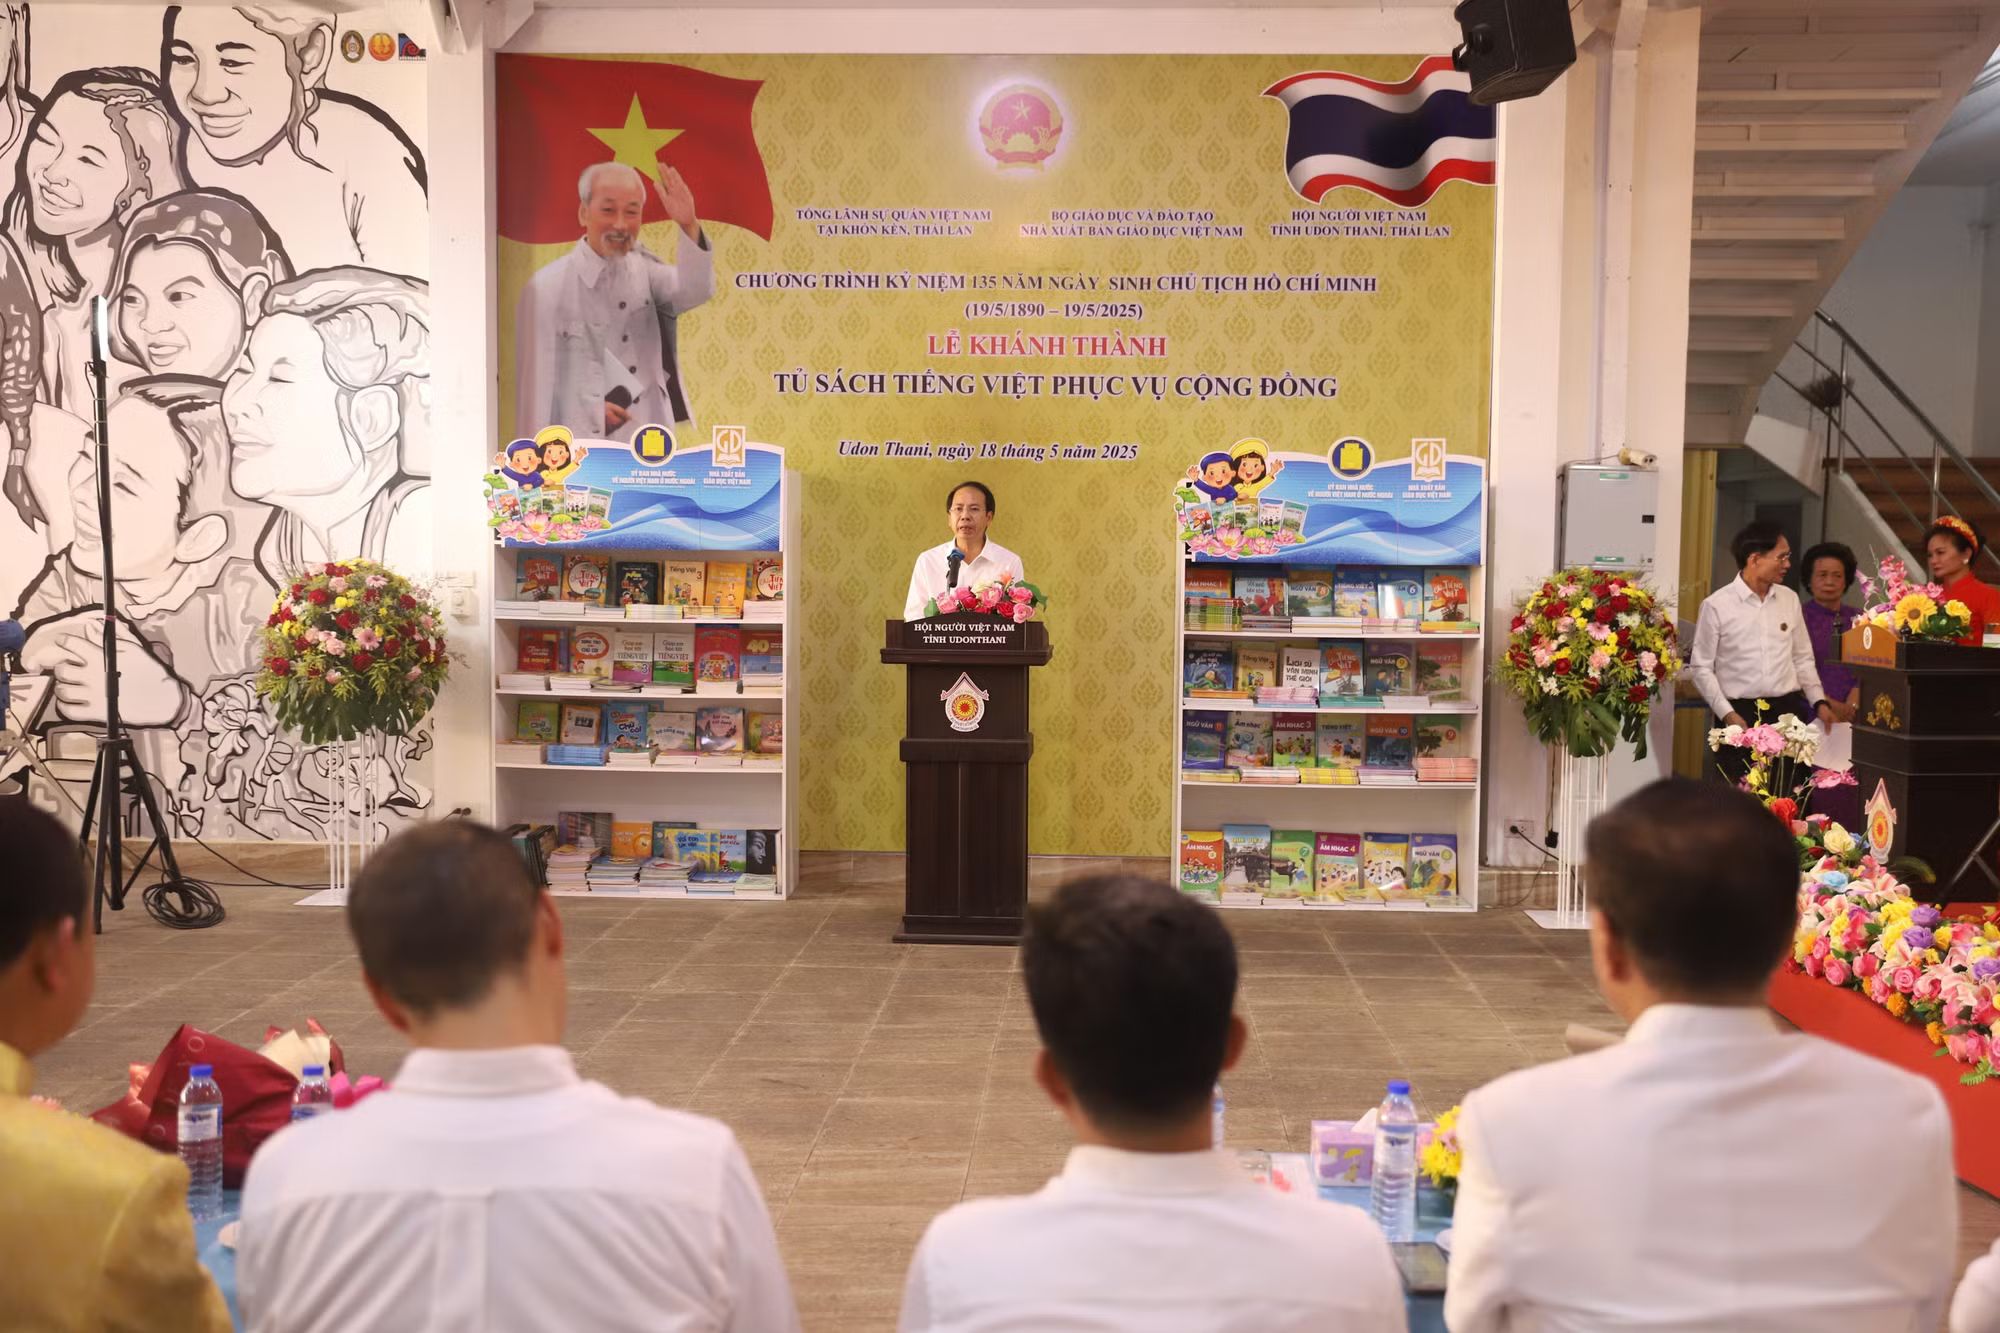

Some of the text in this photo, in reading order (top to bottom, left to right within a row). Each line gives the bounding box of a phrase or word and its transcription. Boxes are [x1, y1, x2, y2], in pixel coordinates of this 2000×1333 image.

[931, 209, 958, 222] VIỆT
[963, 210, 991, 220] NAM
[1072, 208, 1104, 221] GIÁO
[1107, 211, 1133, 223] DỤC
[1157, 208, 1184, 221] ĐÀO
[1186, 211, 1214, 224] TẠO
[1292, 208, 1426, 223] HỘI NGƯỜI VIỆT NAM
[817, 225, 838, 237] TẠI
[914, 223, 944, 235] THÁI
[948, 225, 973, 235] LAN
[1022, 223, 1047, 236] NHÀ
[1117, 224, 1149, 236] GIÁO
[1152, 226, 1178, 239] DỤC
[1181, 225, 1211, 239] VIỆT
[1214, 227, 1243, 237] NAM
[1305, 225, 1340, 236] UDON
[1390, 224, 1421, 236] THÁI
[1424, 226, 1449, 236] LAN
[735, 270, 1377, 294] CHƯƠNG TRÌNH KỶ NIỆM 135 NĂM NGÀY SINH CHỦ TỊCH HỒ CHÍ MINH
[965, 302, 1045, 320] (19/5/1890
[1064, 302, 1143, 321] 19/5/2025)
[928, 330, 1167, 357] LỄ KHÁNH THÀNH
[774, 368, 1338, 401] TỦ SÁCH TIẾNG VIỆT PHỤC VỤ CỘNG ĐỒNG
[838, 441, 1138, 461] Udon Thani, ngày 18 tháng 5 năm 2025
[914, 622, 1015, 633] HỘI NGƯỜI VIỆT NAM
[746, 639, 769, 652] 40
[949, 636, 1006, 644] UDONTHANI
